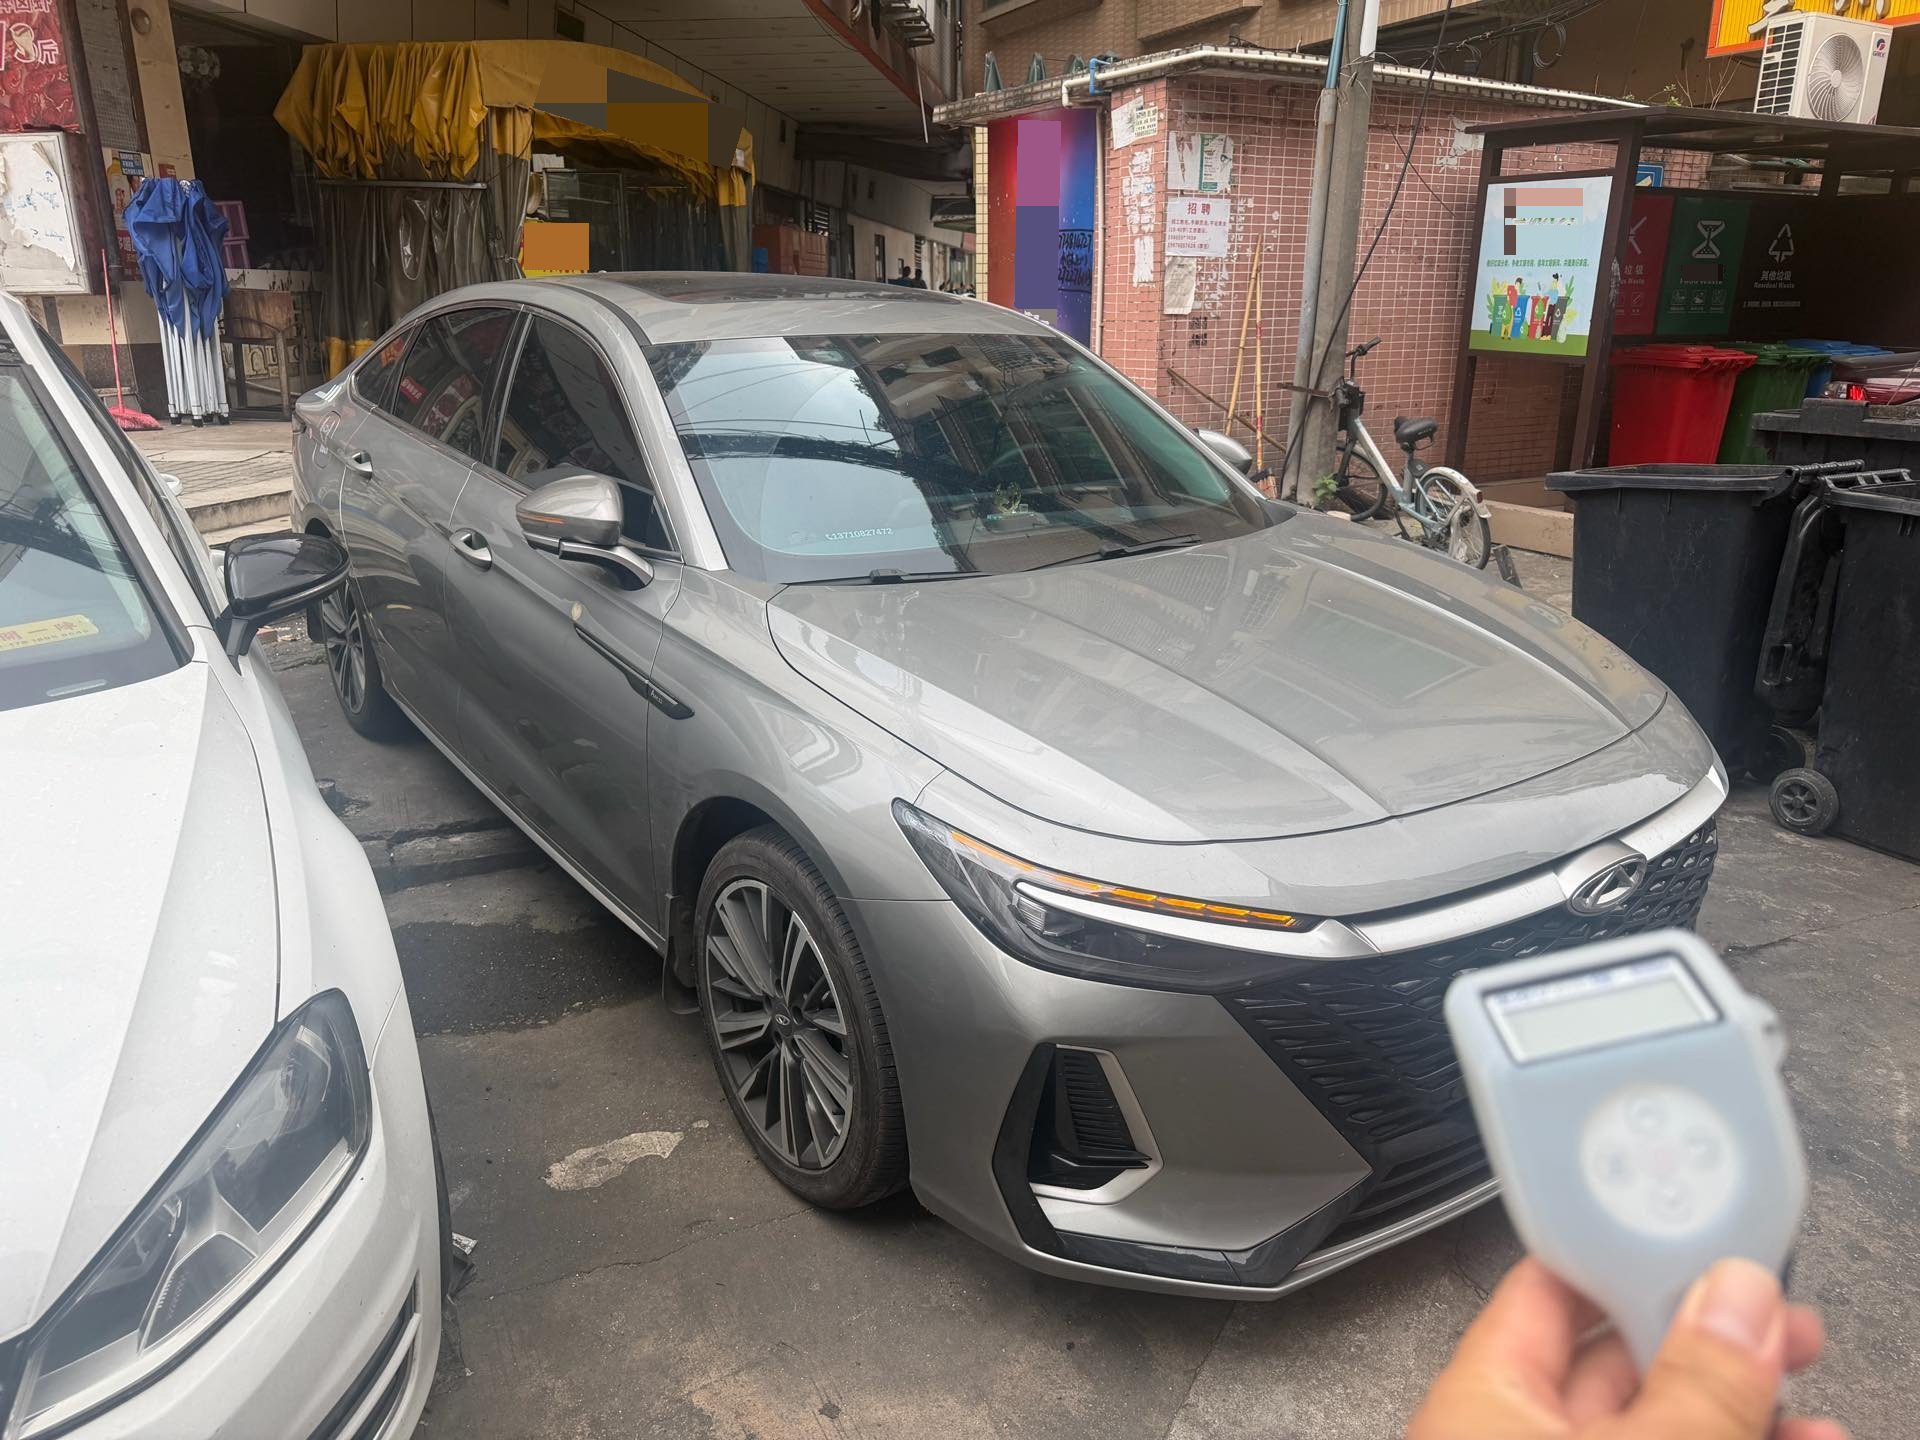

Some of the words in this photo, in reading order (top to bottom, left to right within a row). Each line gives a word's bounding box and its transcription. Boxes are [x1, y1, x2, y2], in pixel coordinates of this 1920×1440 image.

[1187, 202, 1211, 215] 招聘
[1760, 270, 1792, 281] 其他垃圾
